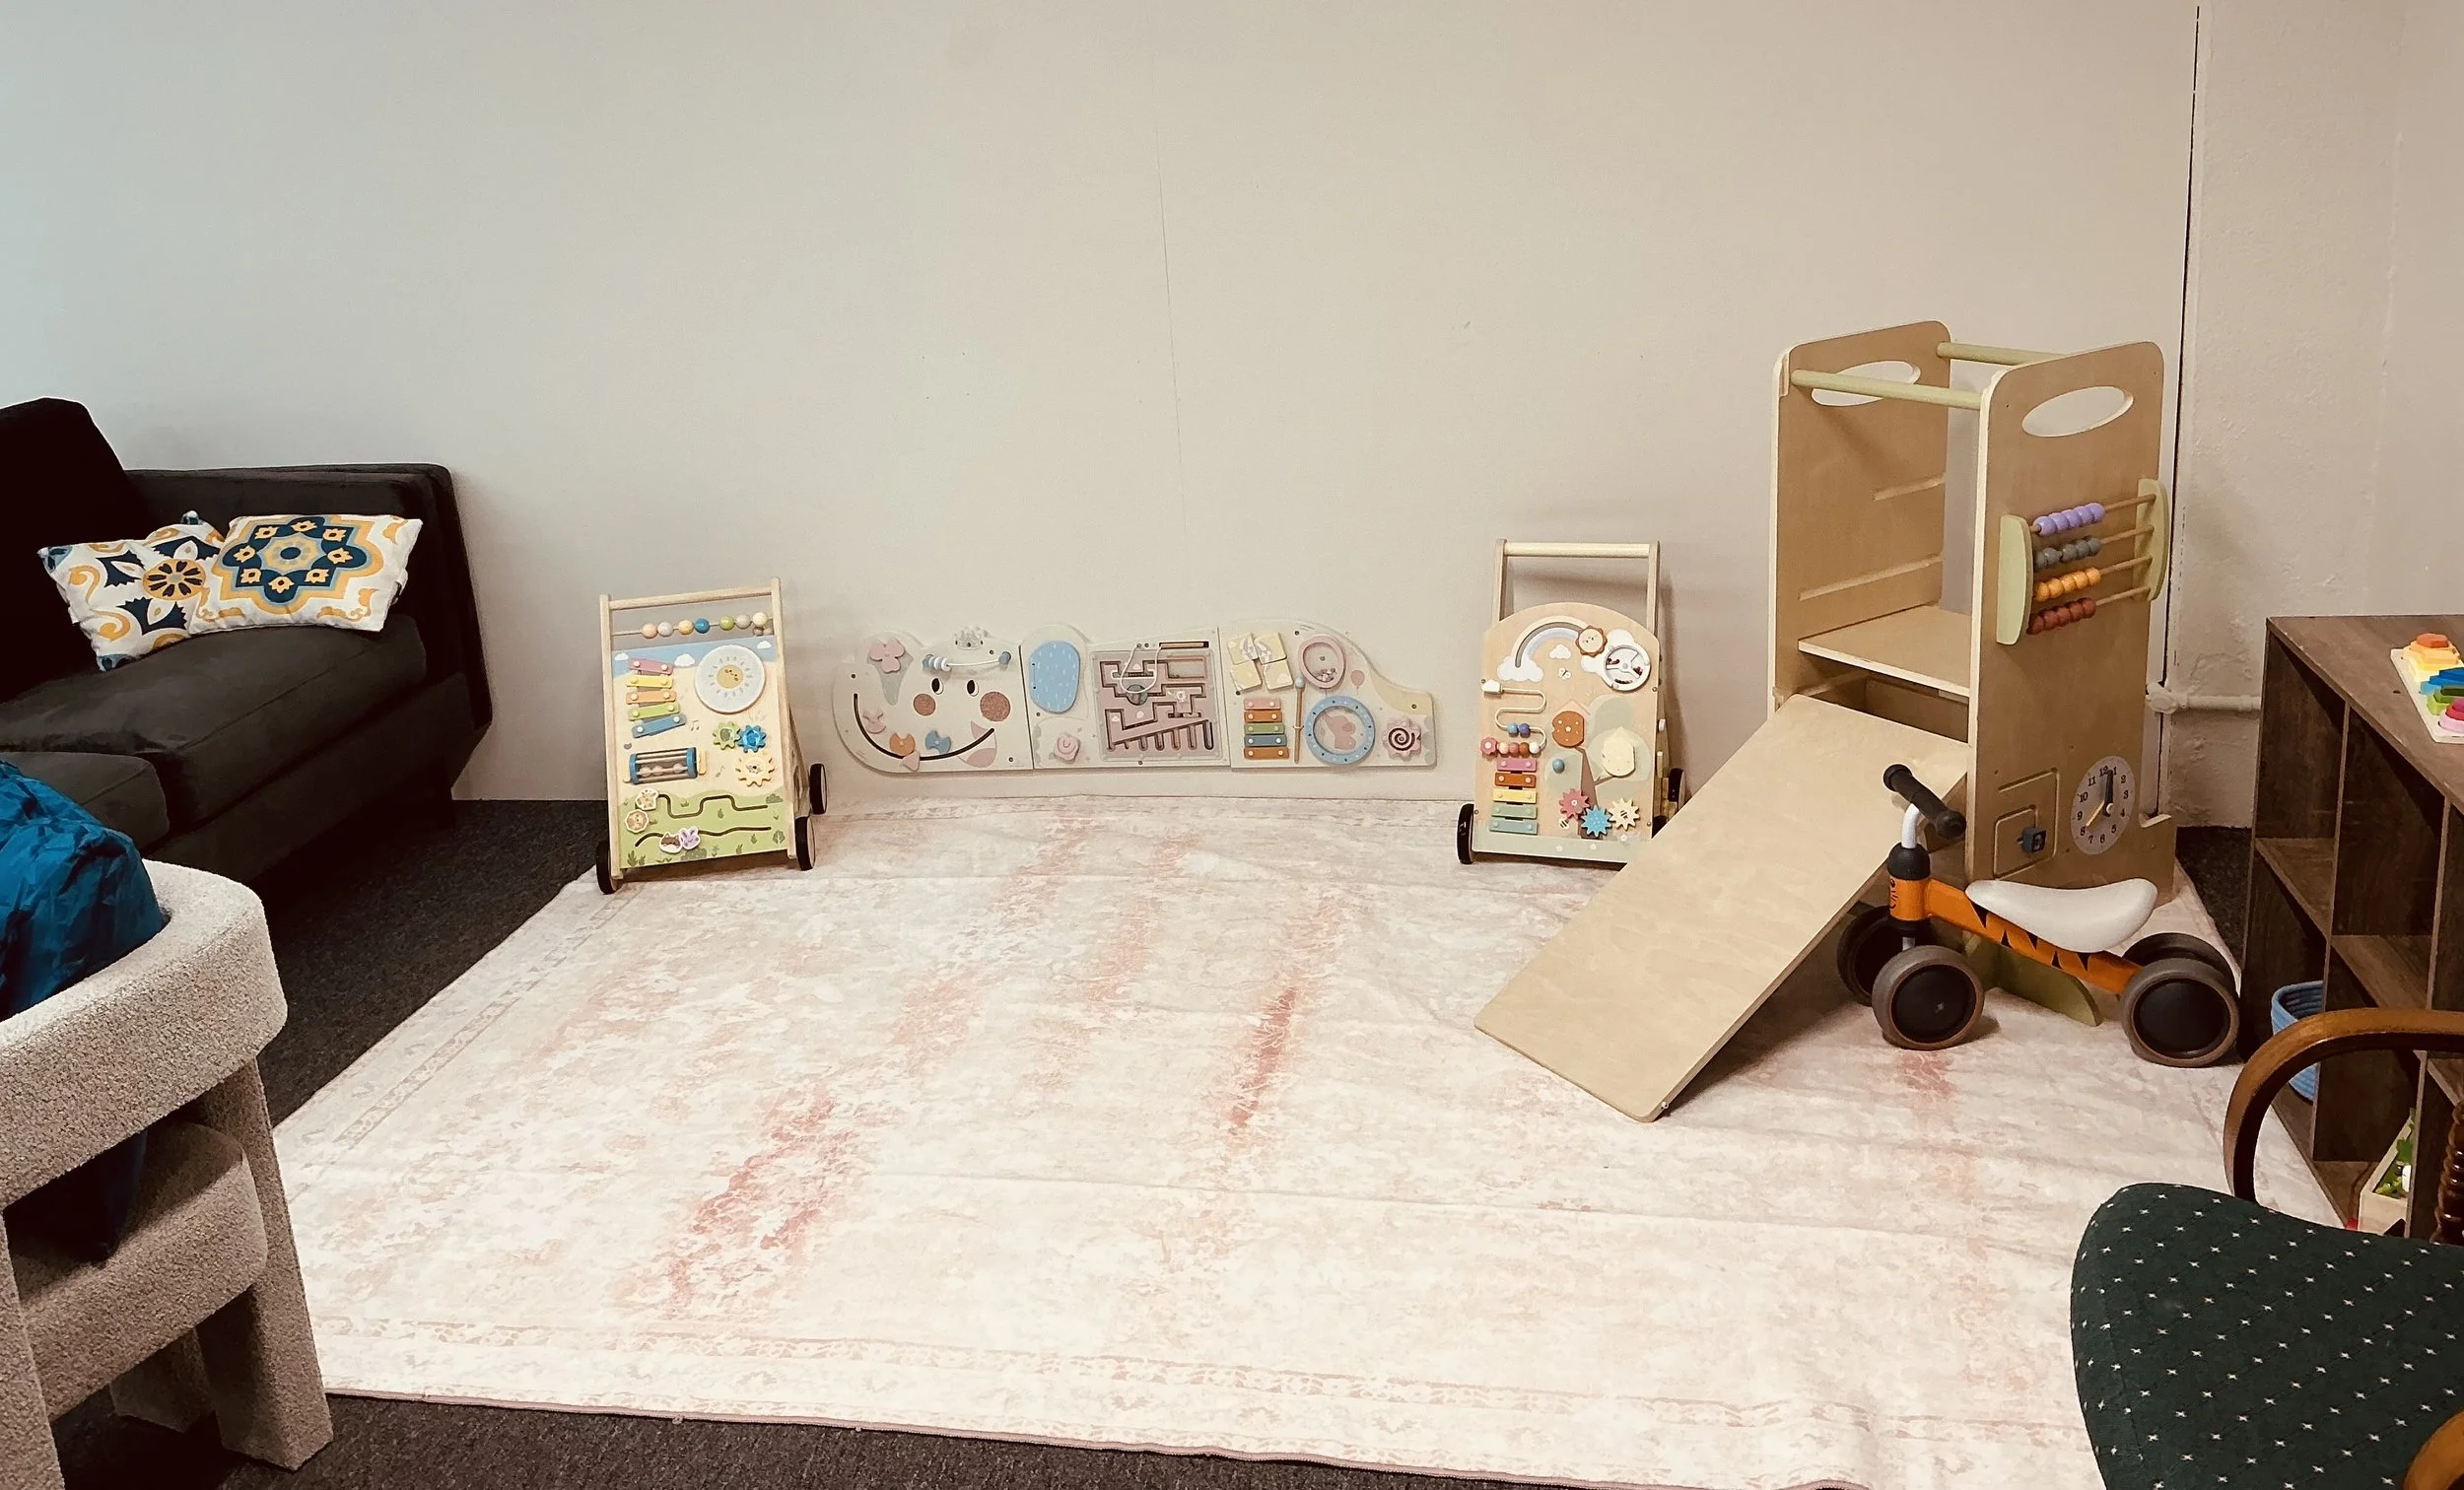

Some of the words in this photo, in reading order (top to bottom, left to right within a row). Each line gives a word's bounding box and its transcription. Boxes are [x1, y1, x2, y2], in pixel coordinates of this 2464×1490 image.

[2099, 765, 2109, 777] 12
[2113, 766, 2117, 776] 1
[2088, 776, 2096, 786] 11
[2120, 775, 2127, 784] 2
[2080, 791, 2088, 803] 10
[2123, 789, 2129, 799] 3
[2077, 810, 2083, 821] 9
[2120, 808, 2126, 818] 4
[2080, 826, 2086, 836] 8
[2111, 824, 2117, 834] 5
[2088, 835, 2094, 845] 7
[2099, 834, 2105, 844] 6
